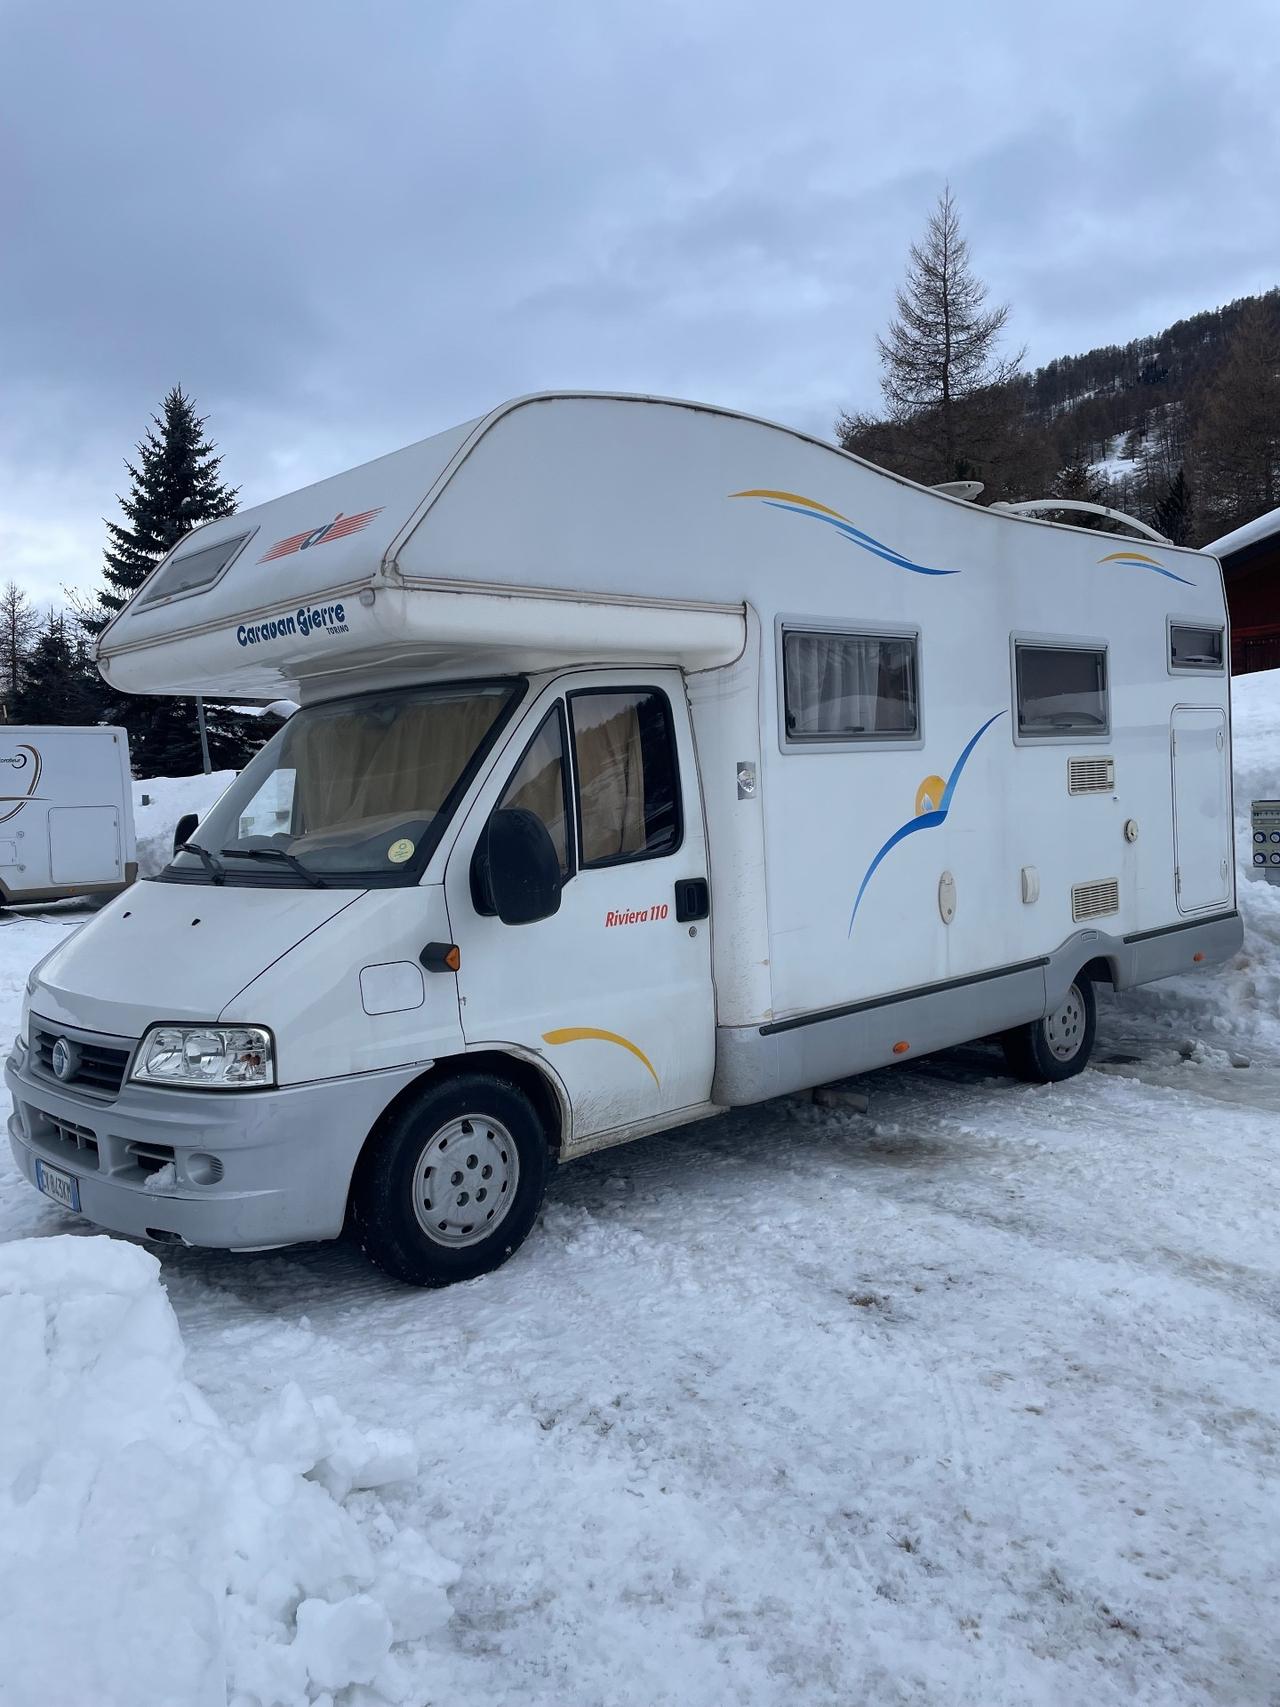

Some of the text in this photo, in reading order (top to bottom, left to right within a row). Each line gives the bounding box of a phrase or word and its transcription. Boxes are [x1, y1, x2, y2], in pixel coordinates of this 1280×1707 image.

[236, 604, 346, 647] Caravan Gierre
[326, 624, 350, 636] TORINO
[605, 904, 668, 928] Riviera 110
